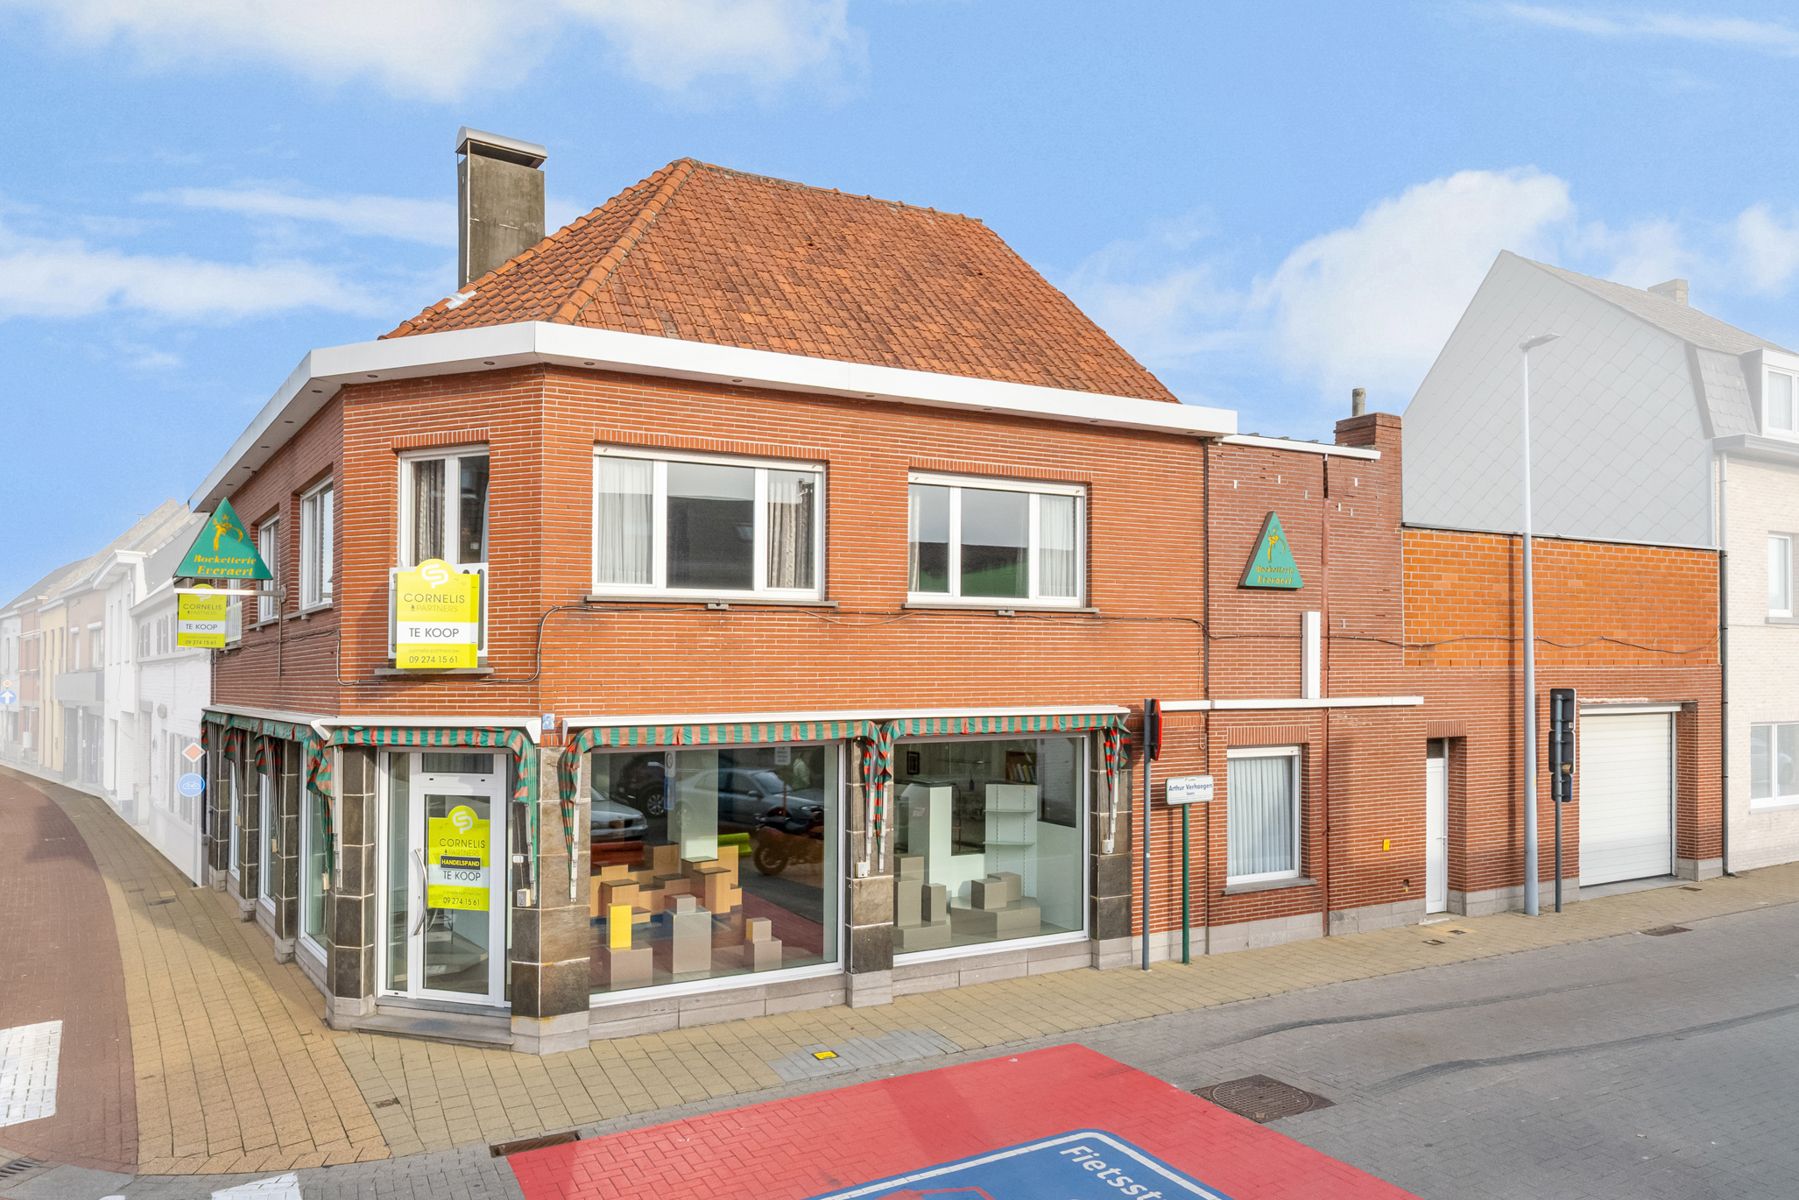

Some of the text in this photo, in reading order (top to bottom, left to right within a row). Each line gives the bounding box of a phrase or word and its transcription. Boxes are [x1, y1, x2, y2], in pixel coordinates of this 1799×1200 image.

[403, 593, 466, 604] CORNELIS
[409, 627, 460, 638] TE KOOP
[409, 655, 458, 664] 09 274 15 61
[439, 838, 486, 849] CORNELIS
[441, 859, 480, 867] HANDELSPAND
[443, 870, 481, 882] TE KOOP
[443, 896, 480, 907] 09 274 15 61
[1059, 1145, 1167, 1200] Fietsst
